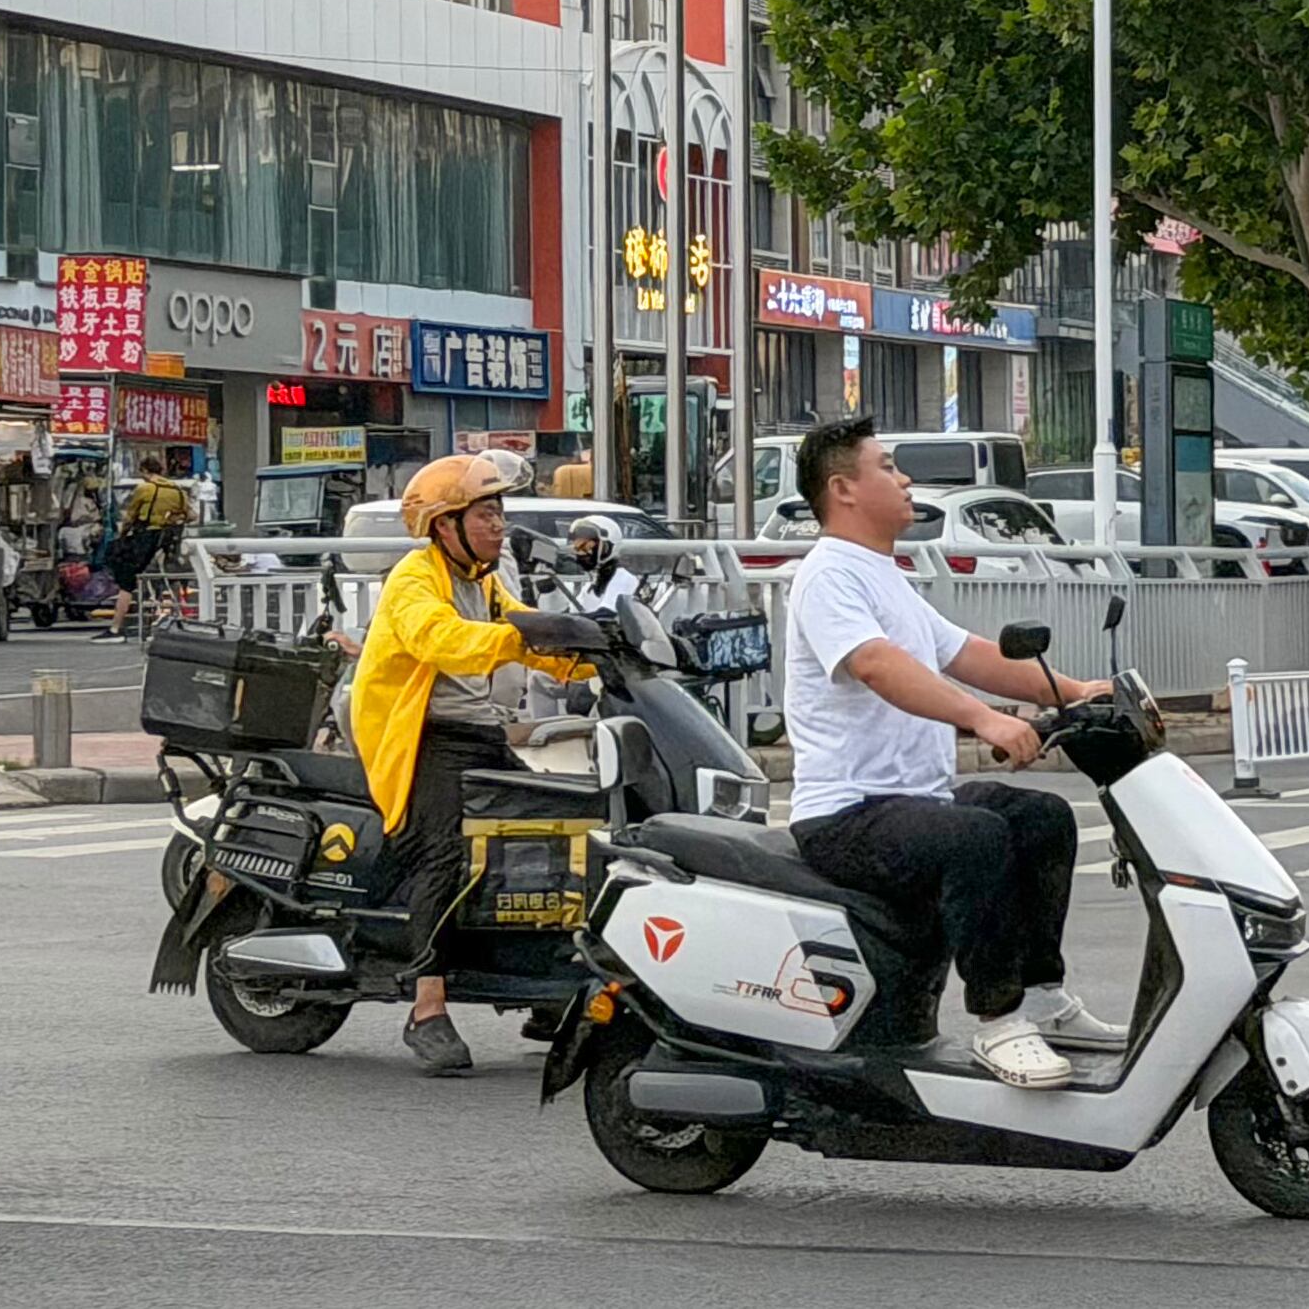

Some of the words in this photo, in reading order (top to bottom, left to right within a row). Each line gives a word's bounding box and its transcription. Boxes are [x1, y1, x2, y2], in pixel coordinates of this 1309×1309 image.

[60, 259, 144, 283] 黄金锅贴
[59, 285, 143, 310] 铁板豆腐
[59, 311, 142, 336] 狼牙土豆
[444, 331, 528, 390] 广告装饰
